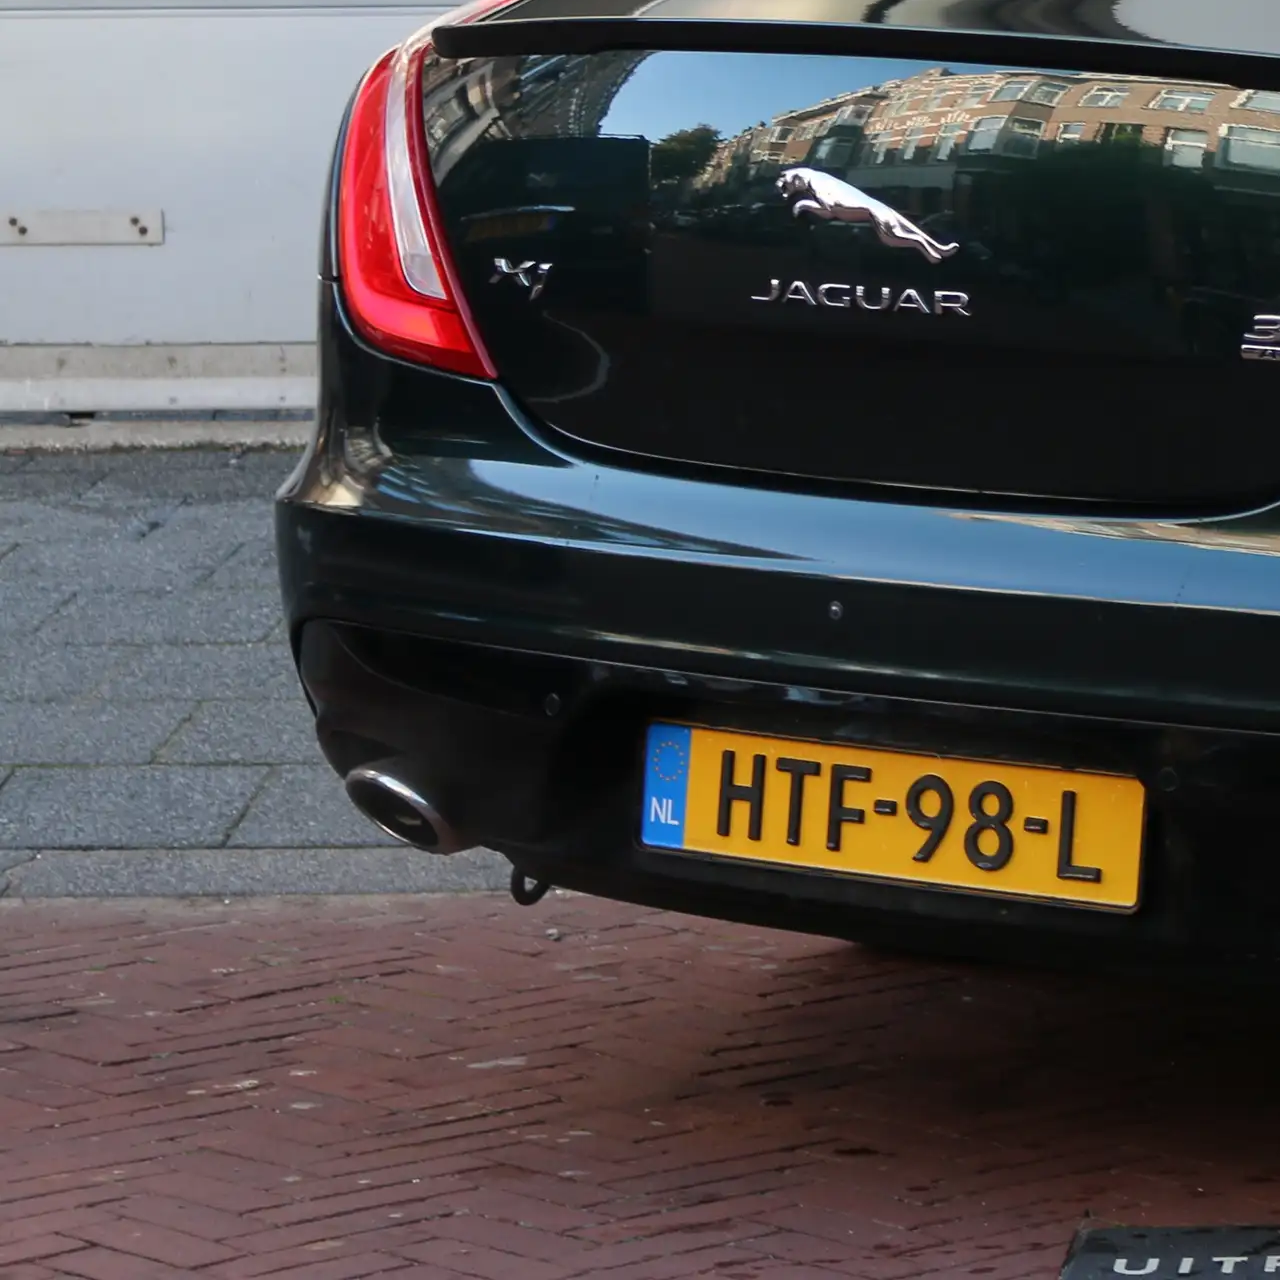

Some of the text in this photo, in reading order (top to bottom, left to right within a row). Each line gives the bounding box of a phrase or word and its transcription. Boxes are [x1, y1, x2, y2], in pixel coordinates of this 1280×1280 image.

[750, 278, 972, 317] JAGUAR
[650, 796, 680, 826] NL
[716, 750, 1102, 883] HTF-98-L
